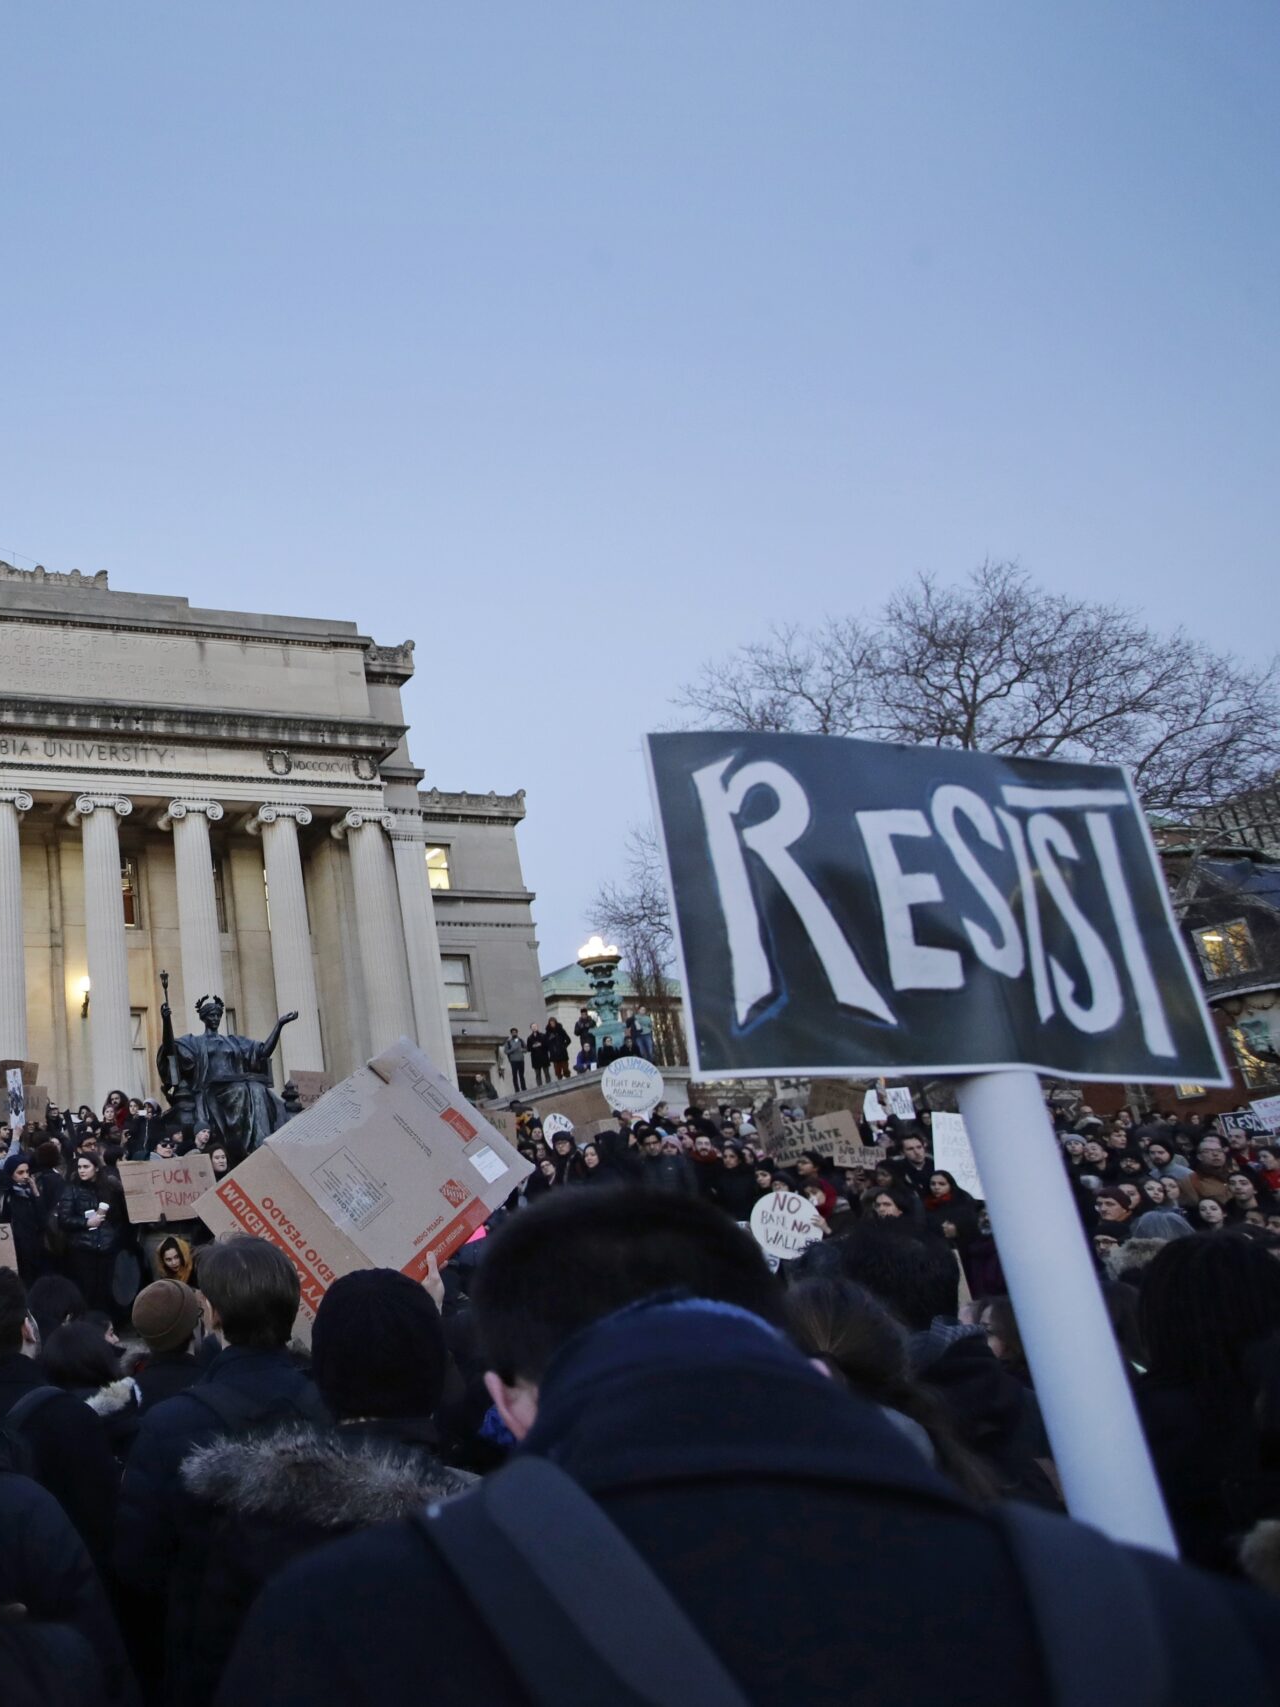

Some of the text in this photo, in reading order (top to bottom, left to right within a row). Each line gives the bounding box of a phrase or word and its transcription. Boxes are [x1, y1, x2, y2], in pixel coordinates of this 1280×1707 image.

[35, 644, 82, 657] GEORGE
[42, 740, 168, 763] UNIVERSITY
[693, 752, 1177, 1058] RESIST
[632, 1079, 652, 1089] BACK
[784, 1120, 818, 1137] OVE
[809, 1128, 842, 1143] HATE
[151, 1168, 192, 1184] FUCK
[154, 1190, 201, 1206] TRUMP
[772, 1193, 802, 1215] NO
[222, 1184, 275, 1243] MEDIUM
[261, 1197, 308, 1251] PESADO
[791, 1219, 811, 1234] NO
[305, 1249, 338, 1284] EDIO
